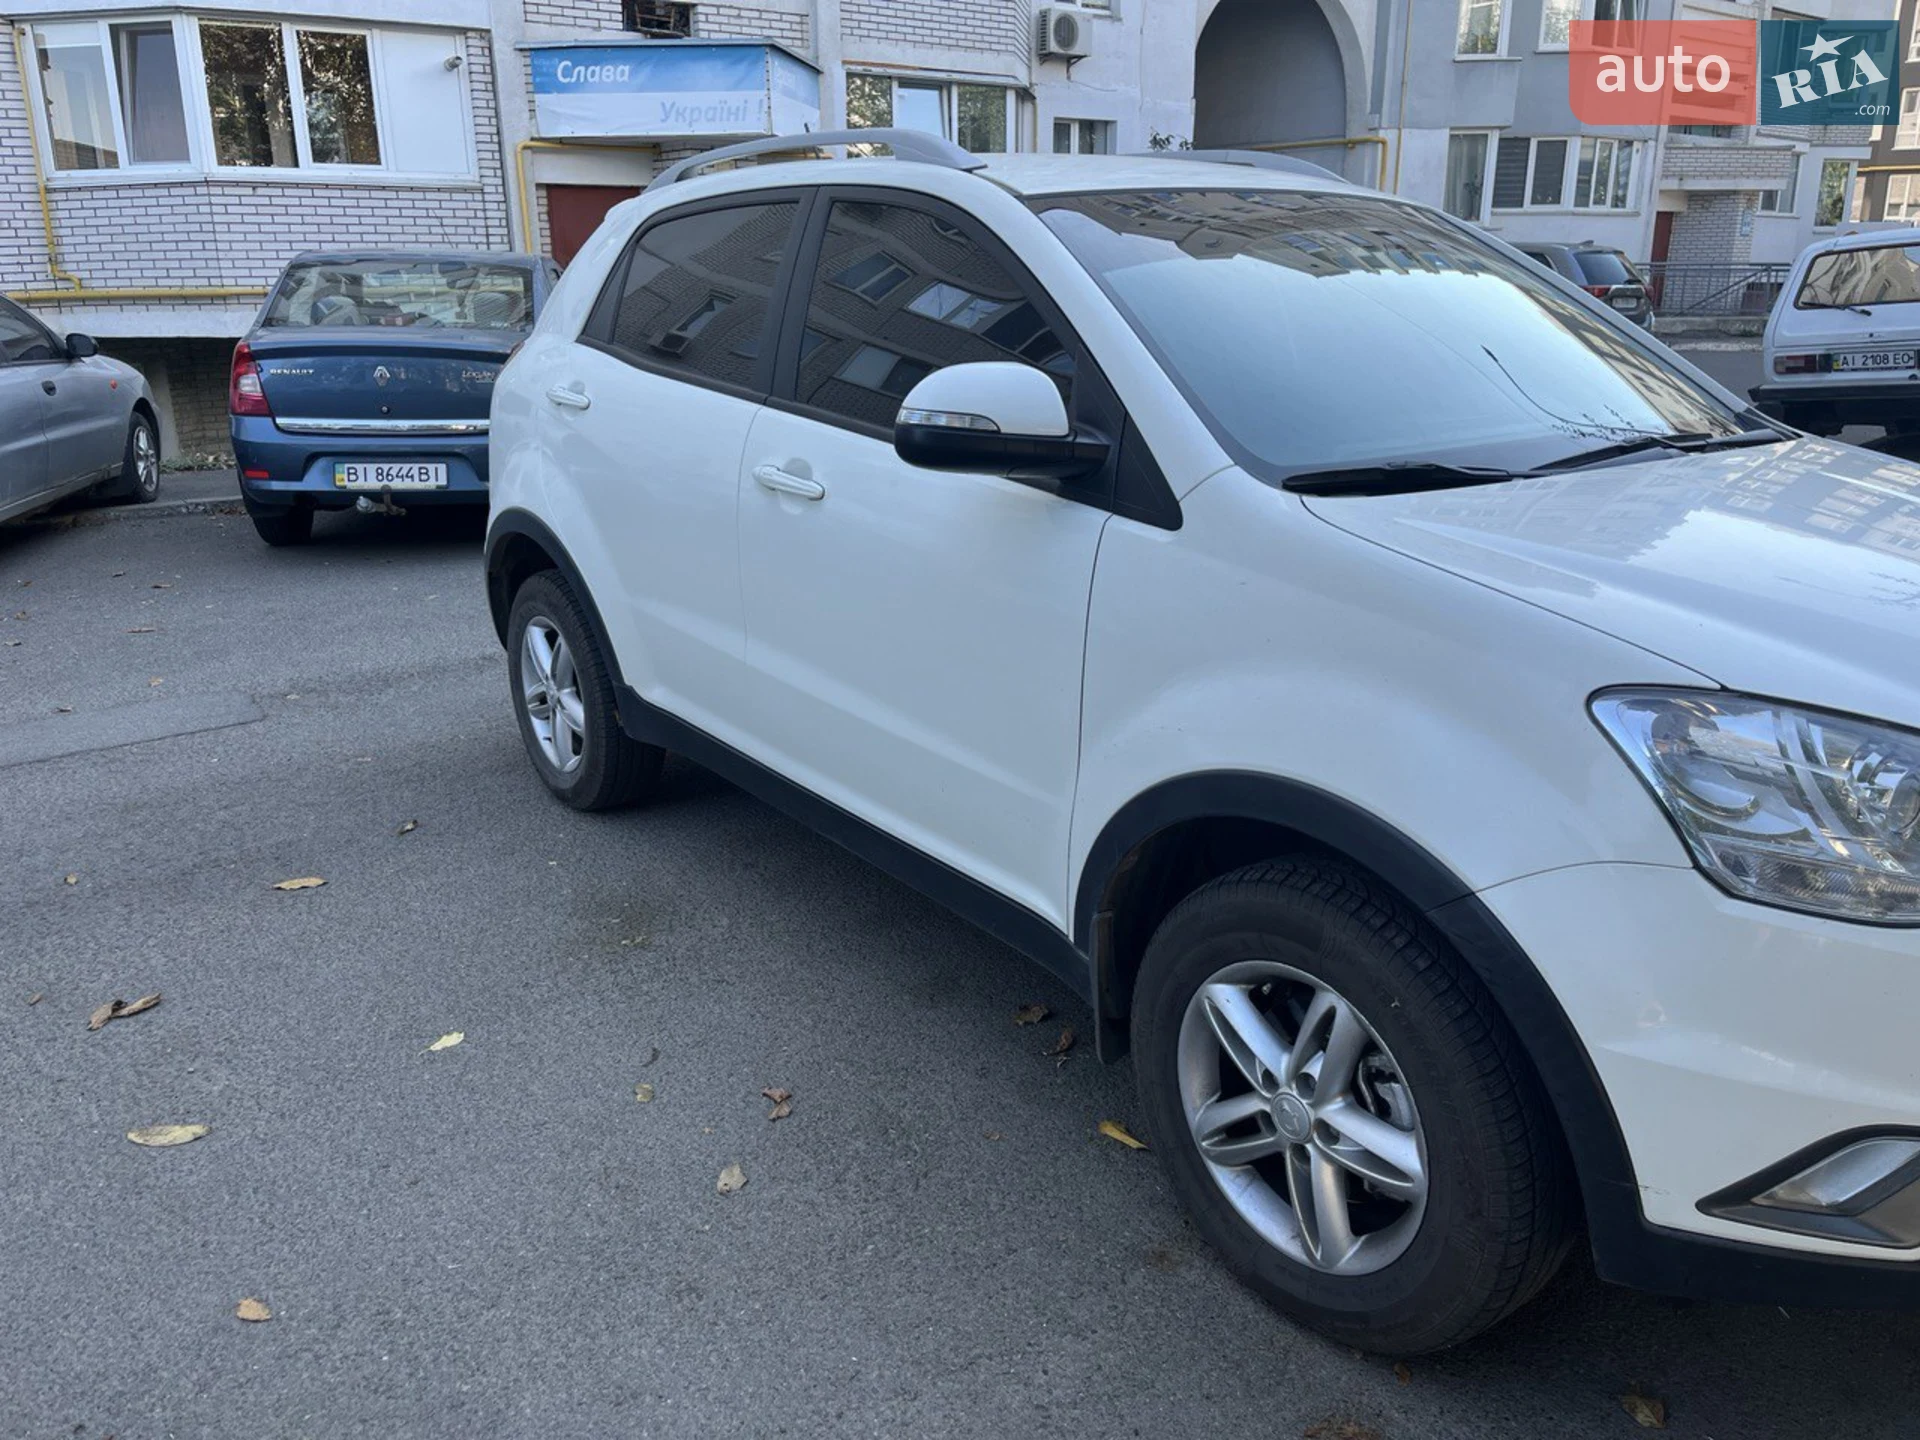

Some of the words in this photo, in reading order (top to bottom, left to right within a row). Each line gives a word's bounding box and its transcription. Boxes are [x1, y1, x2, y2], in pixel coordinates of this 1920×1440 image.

[557, 60, 630, 83] Слава
[661, 99, 748, 128] Україні
[1841, 355, 1855, 367] AI
[1862, 353, 1890, 366] 2108
[346, 466, 367, 482] BI
[375, 466, 415, 482] 8644
